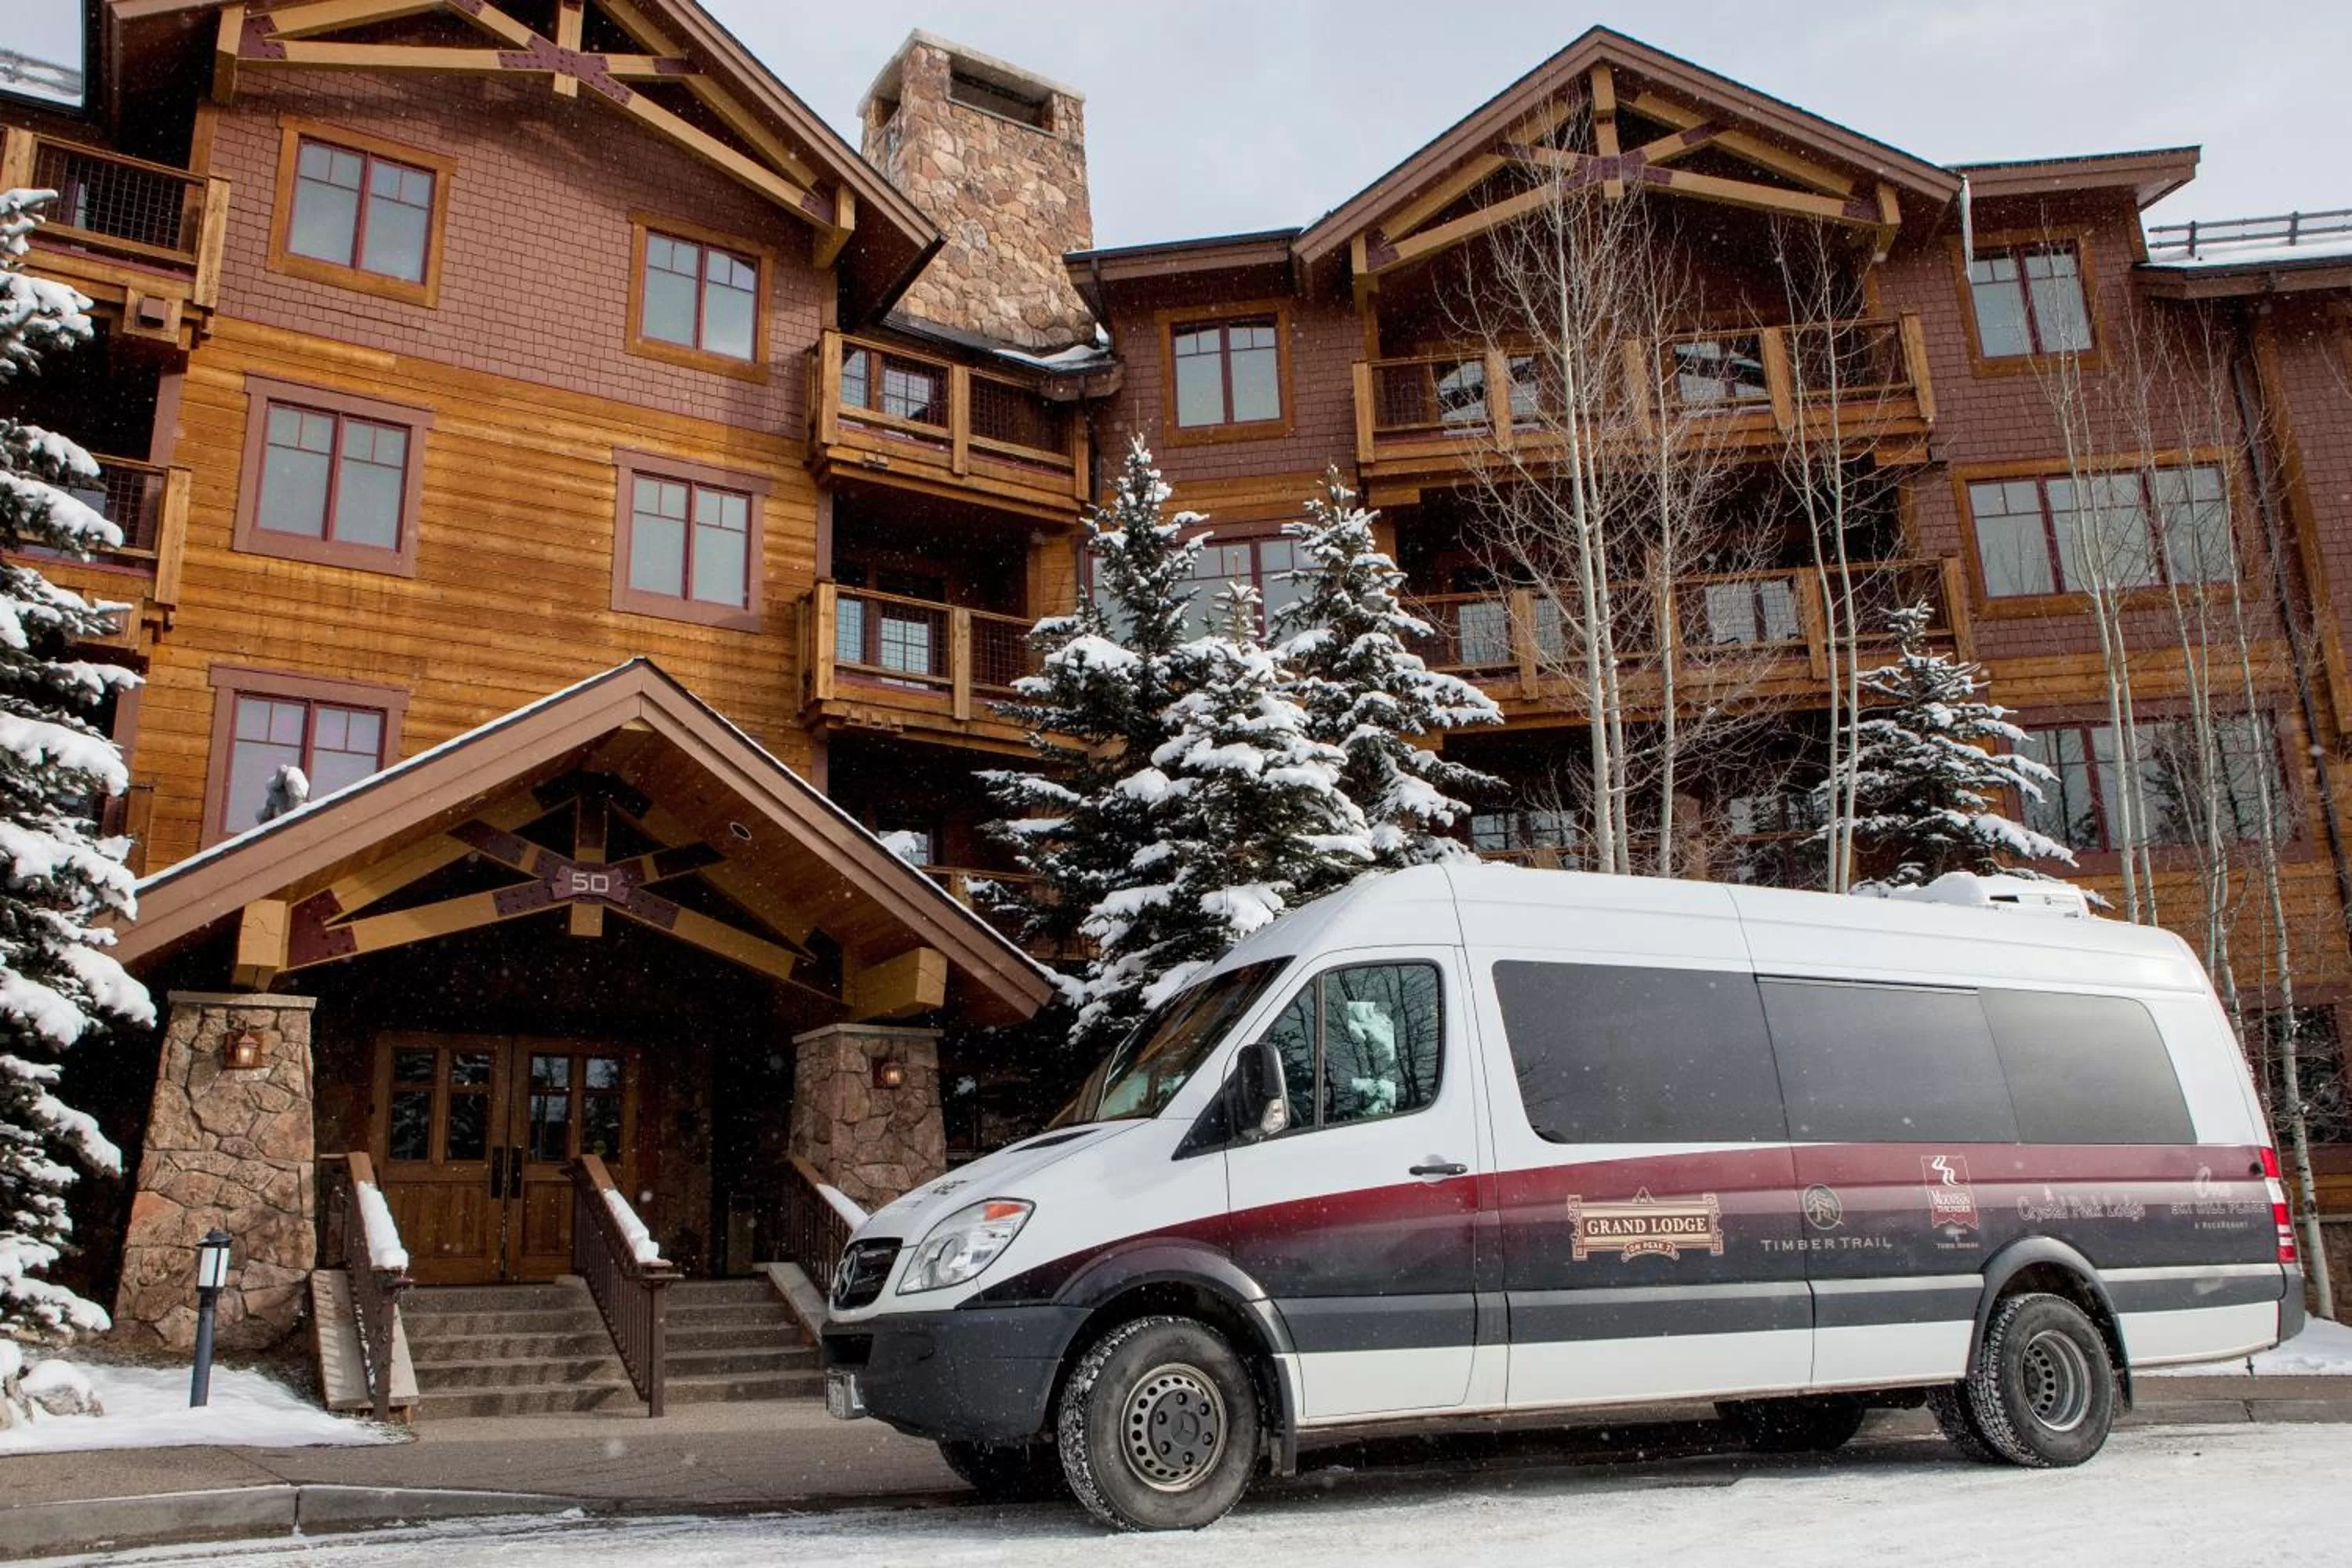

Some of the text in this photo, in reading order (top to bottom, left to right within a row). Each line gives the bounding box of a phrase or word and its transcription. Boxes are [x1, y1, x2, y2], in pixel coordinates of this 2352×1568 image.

[572, 873, 609, 893] 50
[1587, 1218, 1707, 1235] GRAND LODGE
[1760, 1236, 1894, 1252] TIMBER TRAIL
